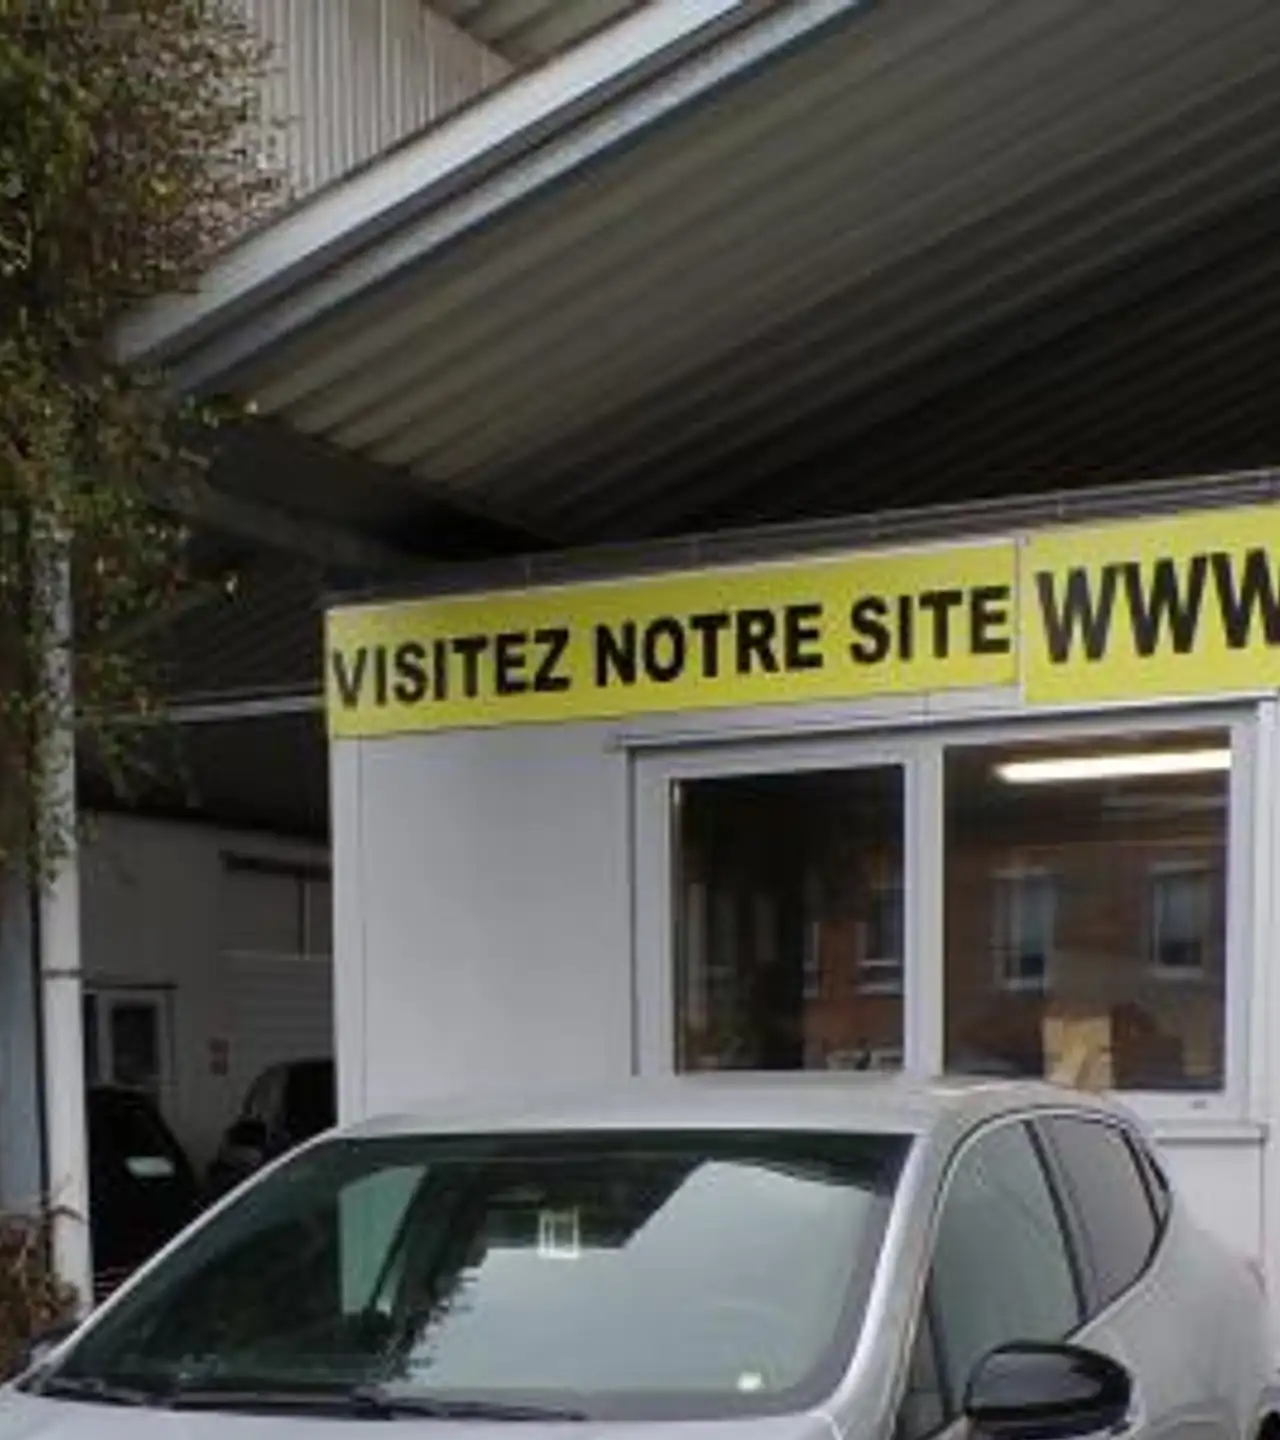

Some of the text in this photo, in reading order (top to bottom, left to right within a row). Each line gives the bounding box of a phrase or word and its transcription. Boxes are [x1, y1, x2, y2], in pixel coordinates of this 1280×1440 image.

[332, 584, 1011, 708] VISITEZ NOTRE SITE
